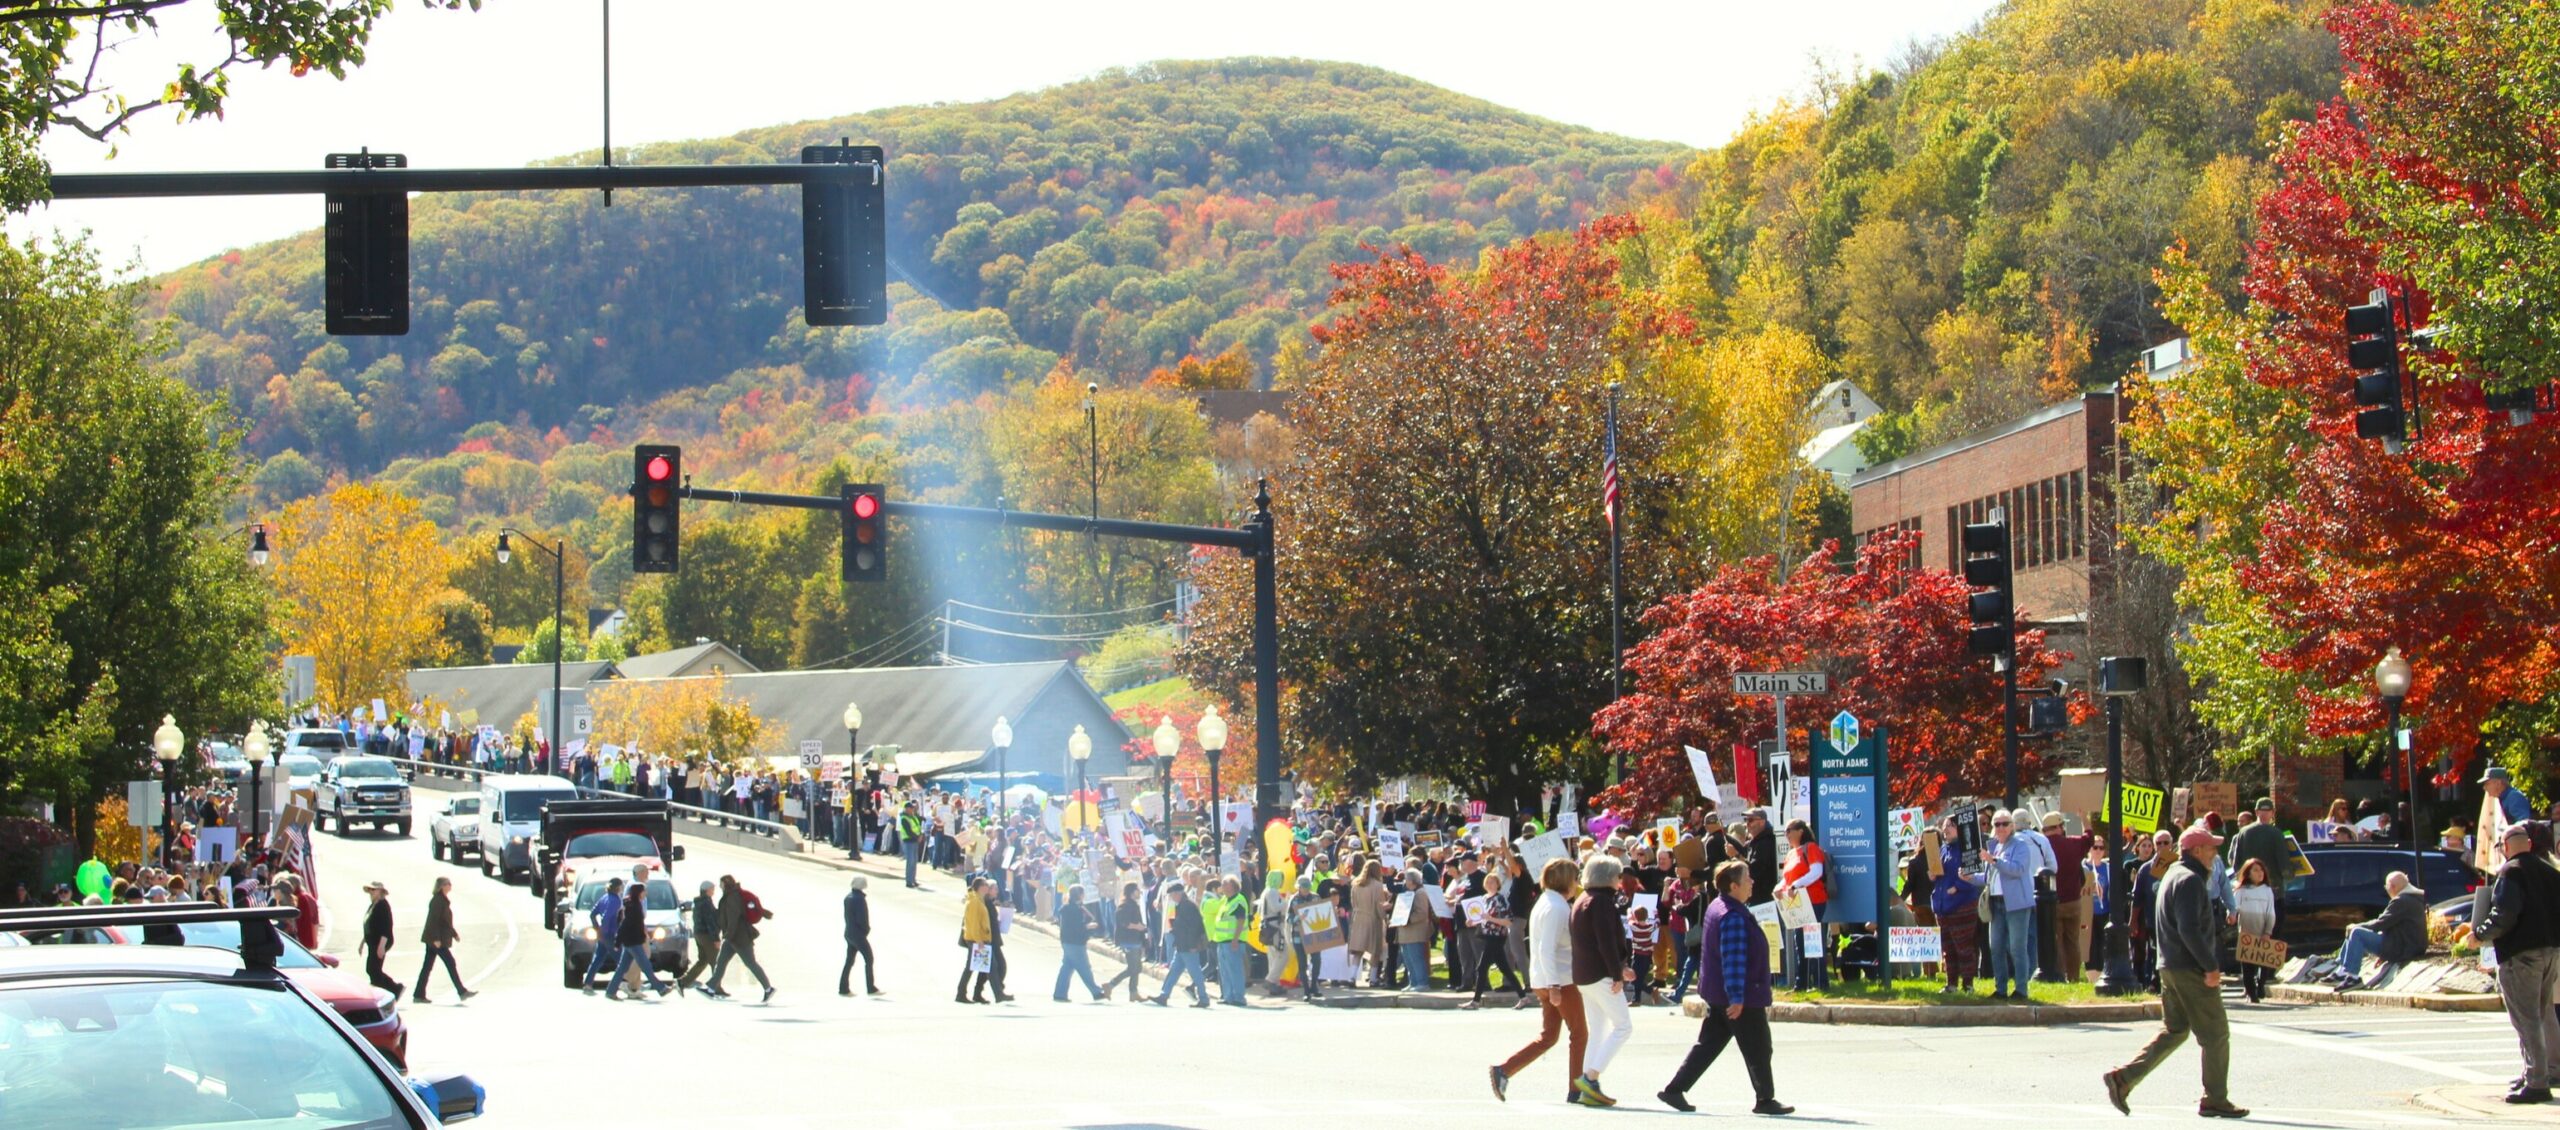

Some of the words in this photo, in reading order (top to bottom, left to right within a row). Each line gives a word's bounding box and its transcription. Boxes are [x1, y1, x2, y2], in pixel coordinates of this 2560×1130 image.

[1738, 675, 1790, 692] Main
[1797, 674, 1823, 691] St.
[579, 719, 586, 730] 8
[803, 754, 821, 766] 30
[1822, 759, 1844, 768] NORTH
[1846, 758, 1869, 768] ADAMS
[1828, 784, 1847, 794] MASS
[1848, 784, 1867, 793] MoCA
[1828, 800, 1848, 810] Public
[2120, 787, 2160, 818] SIST
[1828, 811, 1853, 822] Parking
[1957, 811, 1974, 826] ASS
[1829, 827, 1844, 837] BMC
[1844, 826, 1865, 836] Health
[1122, 830, 1143, 845] NO
[1829, 838, 1835, 847] &
[1835, 838, 1871, 848] Emergency
[1840, 864, 1868, 876] Greylock
[1890, 927, 1904, 936] NO
[1906, 927, 1932, 937] KINGS
[2254, 938, 2270, 950] NO
